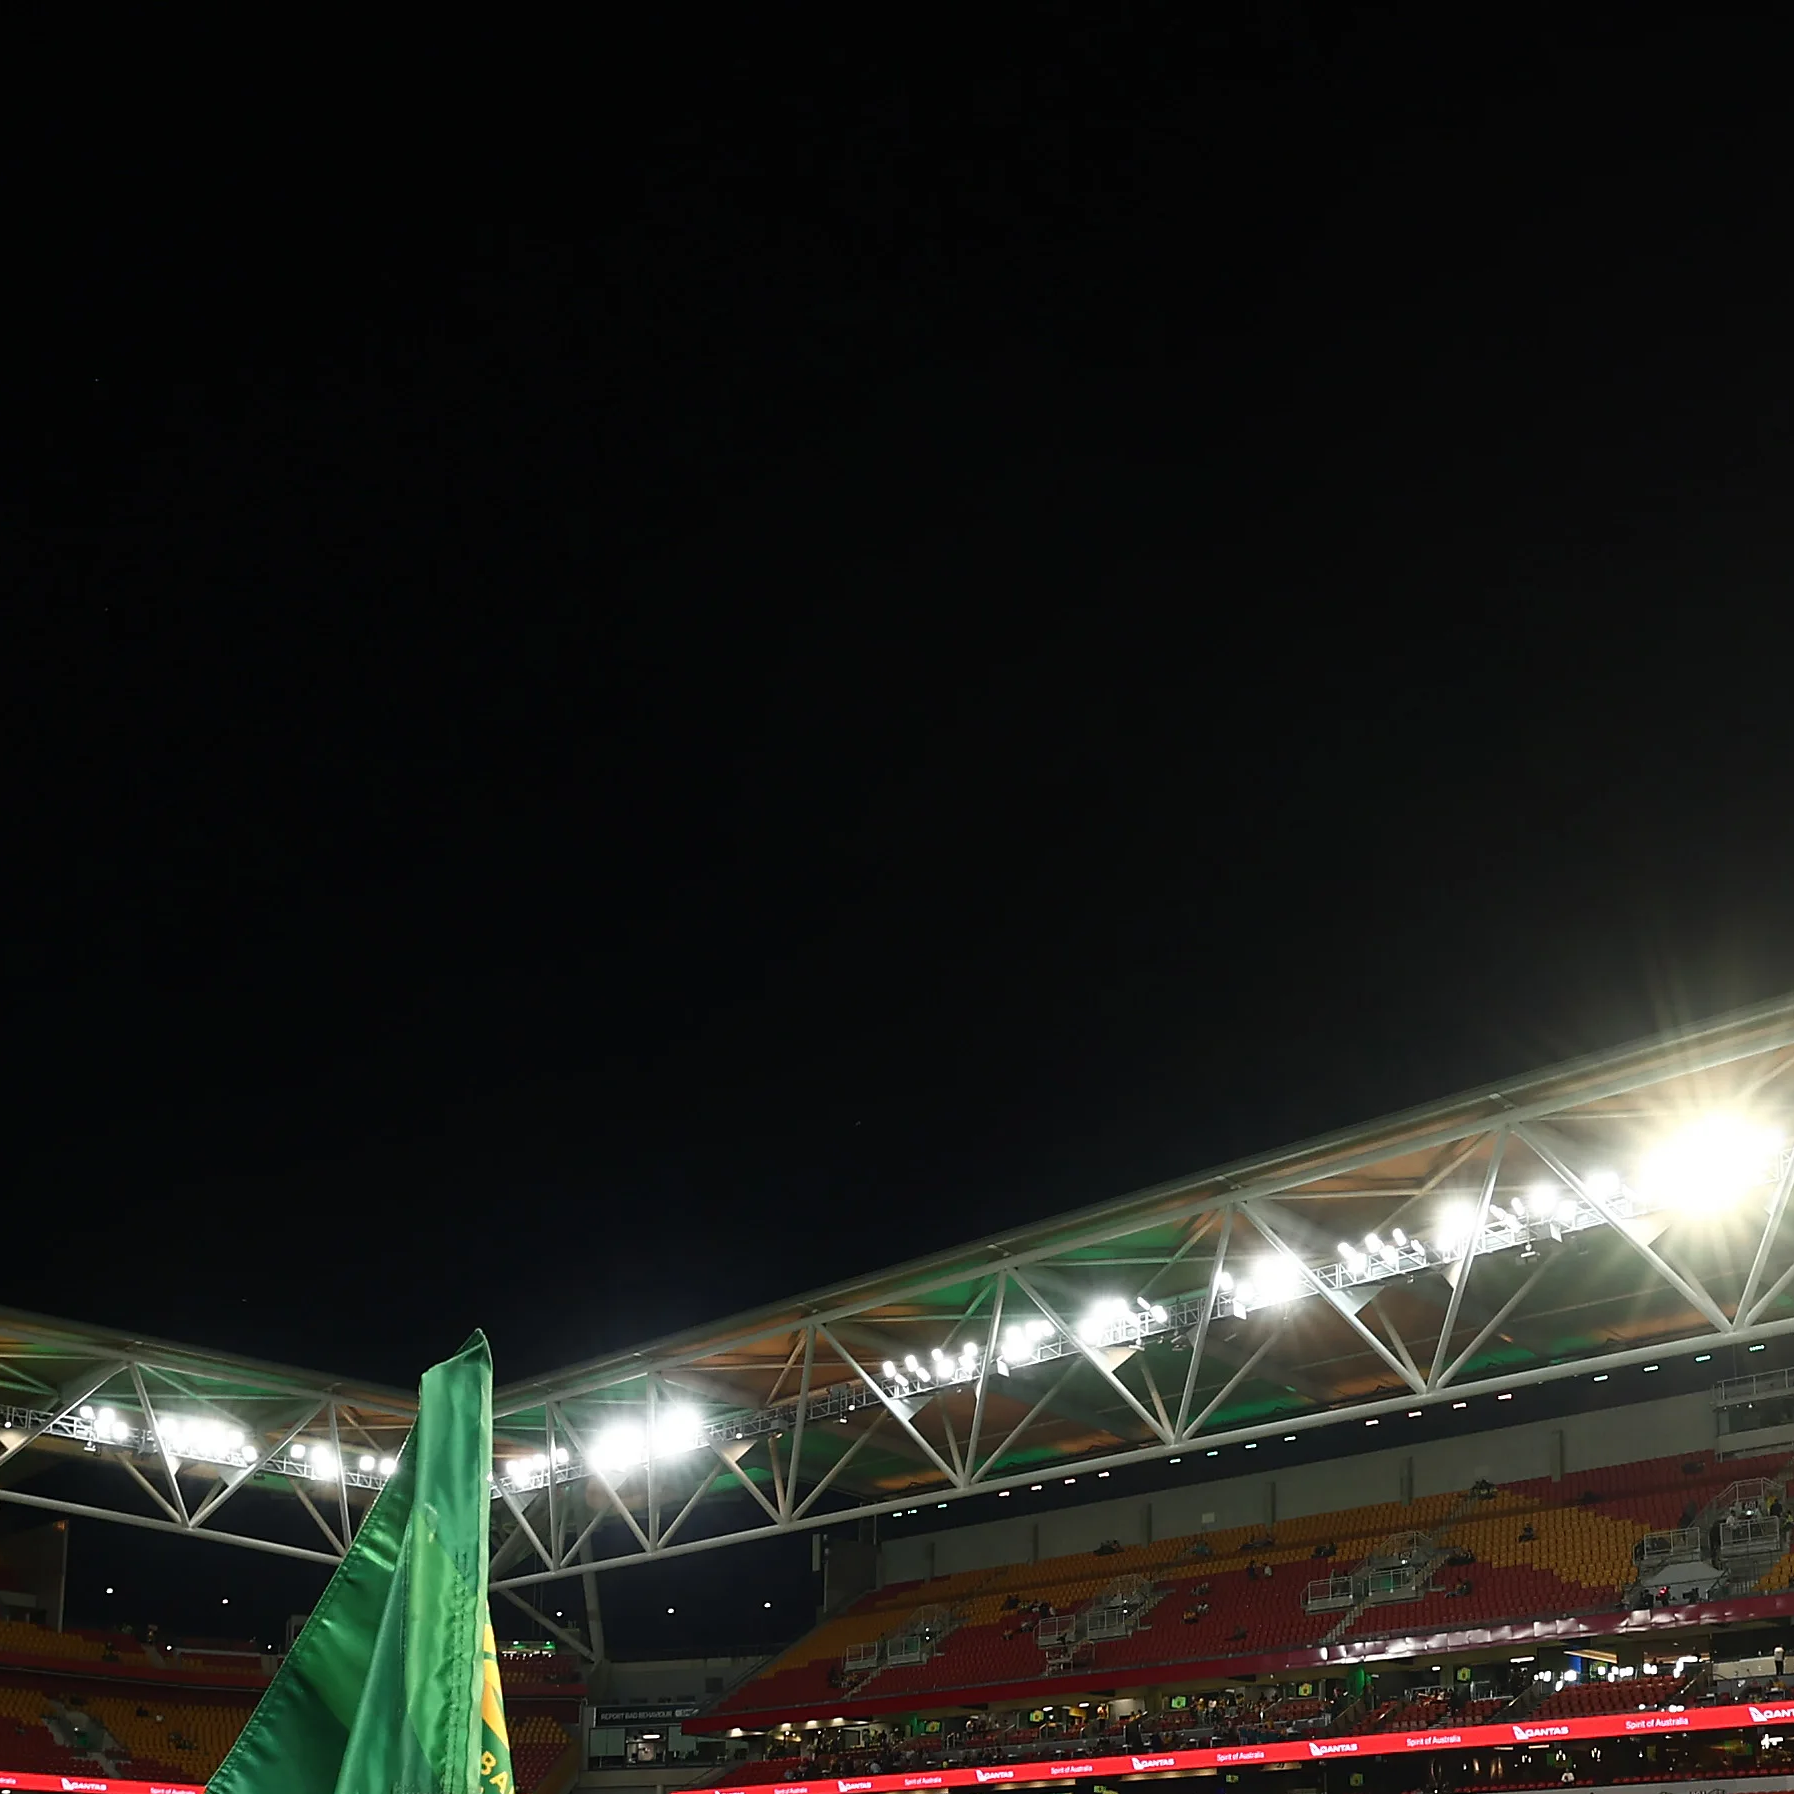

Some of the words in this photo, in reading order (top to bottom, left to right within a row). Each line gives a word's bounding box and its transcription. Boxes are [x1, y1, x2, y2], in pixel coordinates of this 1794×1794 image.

[1625, 1718, 1644, 1730] Spirit
[1654, 1717, 1689, 1728] Australia
[1526, 1726, 1569, 1738] QANTAS
[1407, 1738, 1424, 1748] Spirit
[1432, 1736, 1462, 1746] Australia
[1319, 1744, 1358, 1754] QANTAS
[1142, 1758, 1175, 1768] QANTAS
[1217, 1754, 1232, 1764] Spirit
[1238, 1752, 1265, 1762] Australia
[985, 1771, 1014, 1780] QANTAS
[71, 1782, 108, 1792] QANTAS
[847, 1782, 872, 1790] QANTAS
